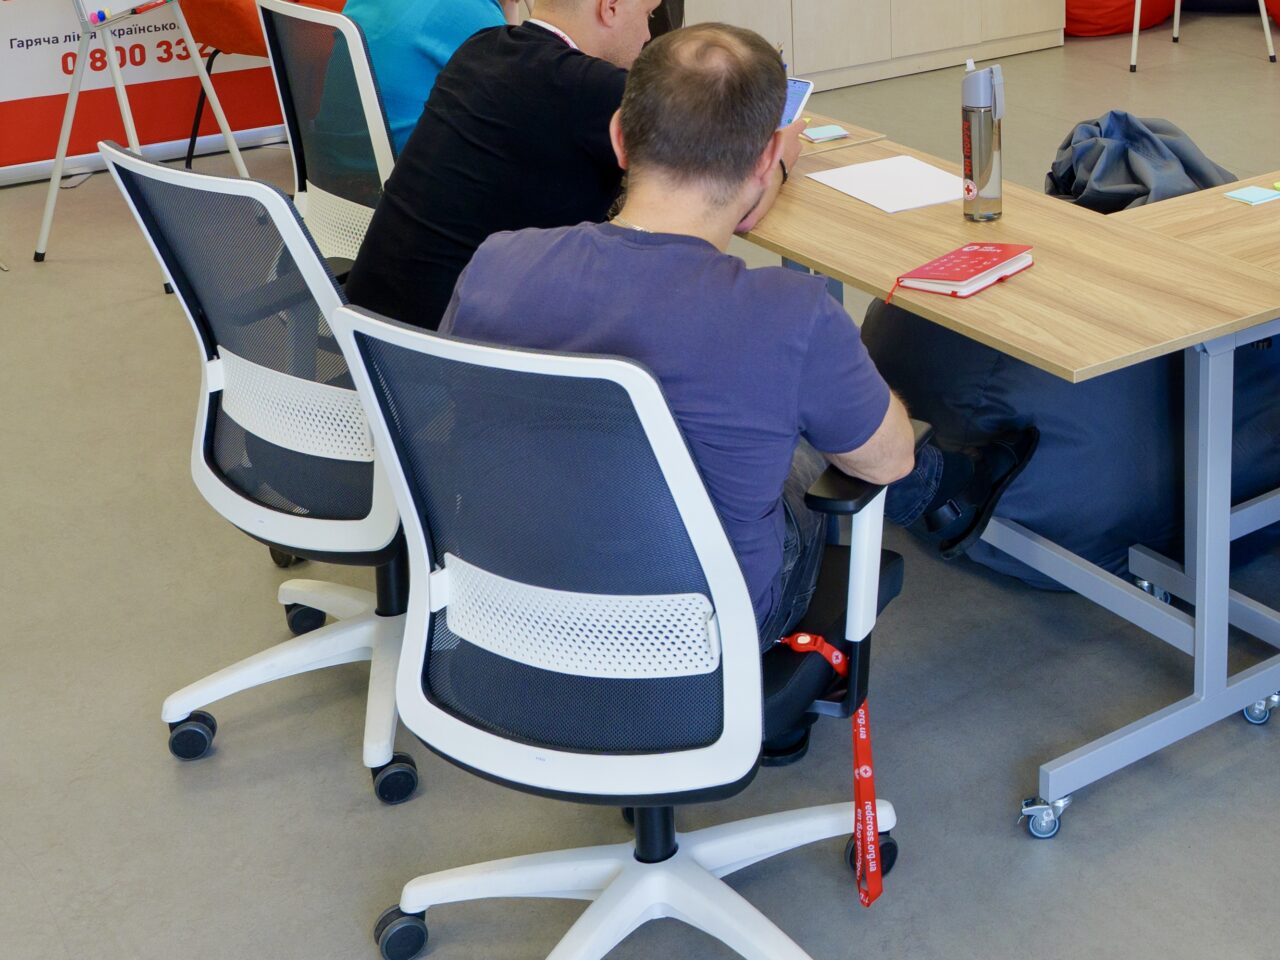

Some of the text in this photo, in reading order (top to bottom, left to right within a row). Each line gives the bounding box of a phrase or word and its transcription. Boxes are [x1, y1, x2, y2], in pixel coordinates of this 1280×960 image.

[9, 21, 180, 50] Гаряча лія країнсько
[865, 801, 877, 872] redcross.org.ua
